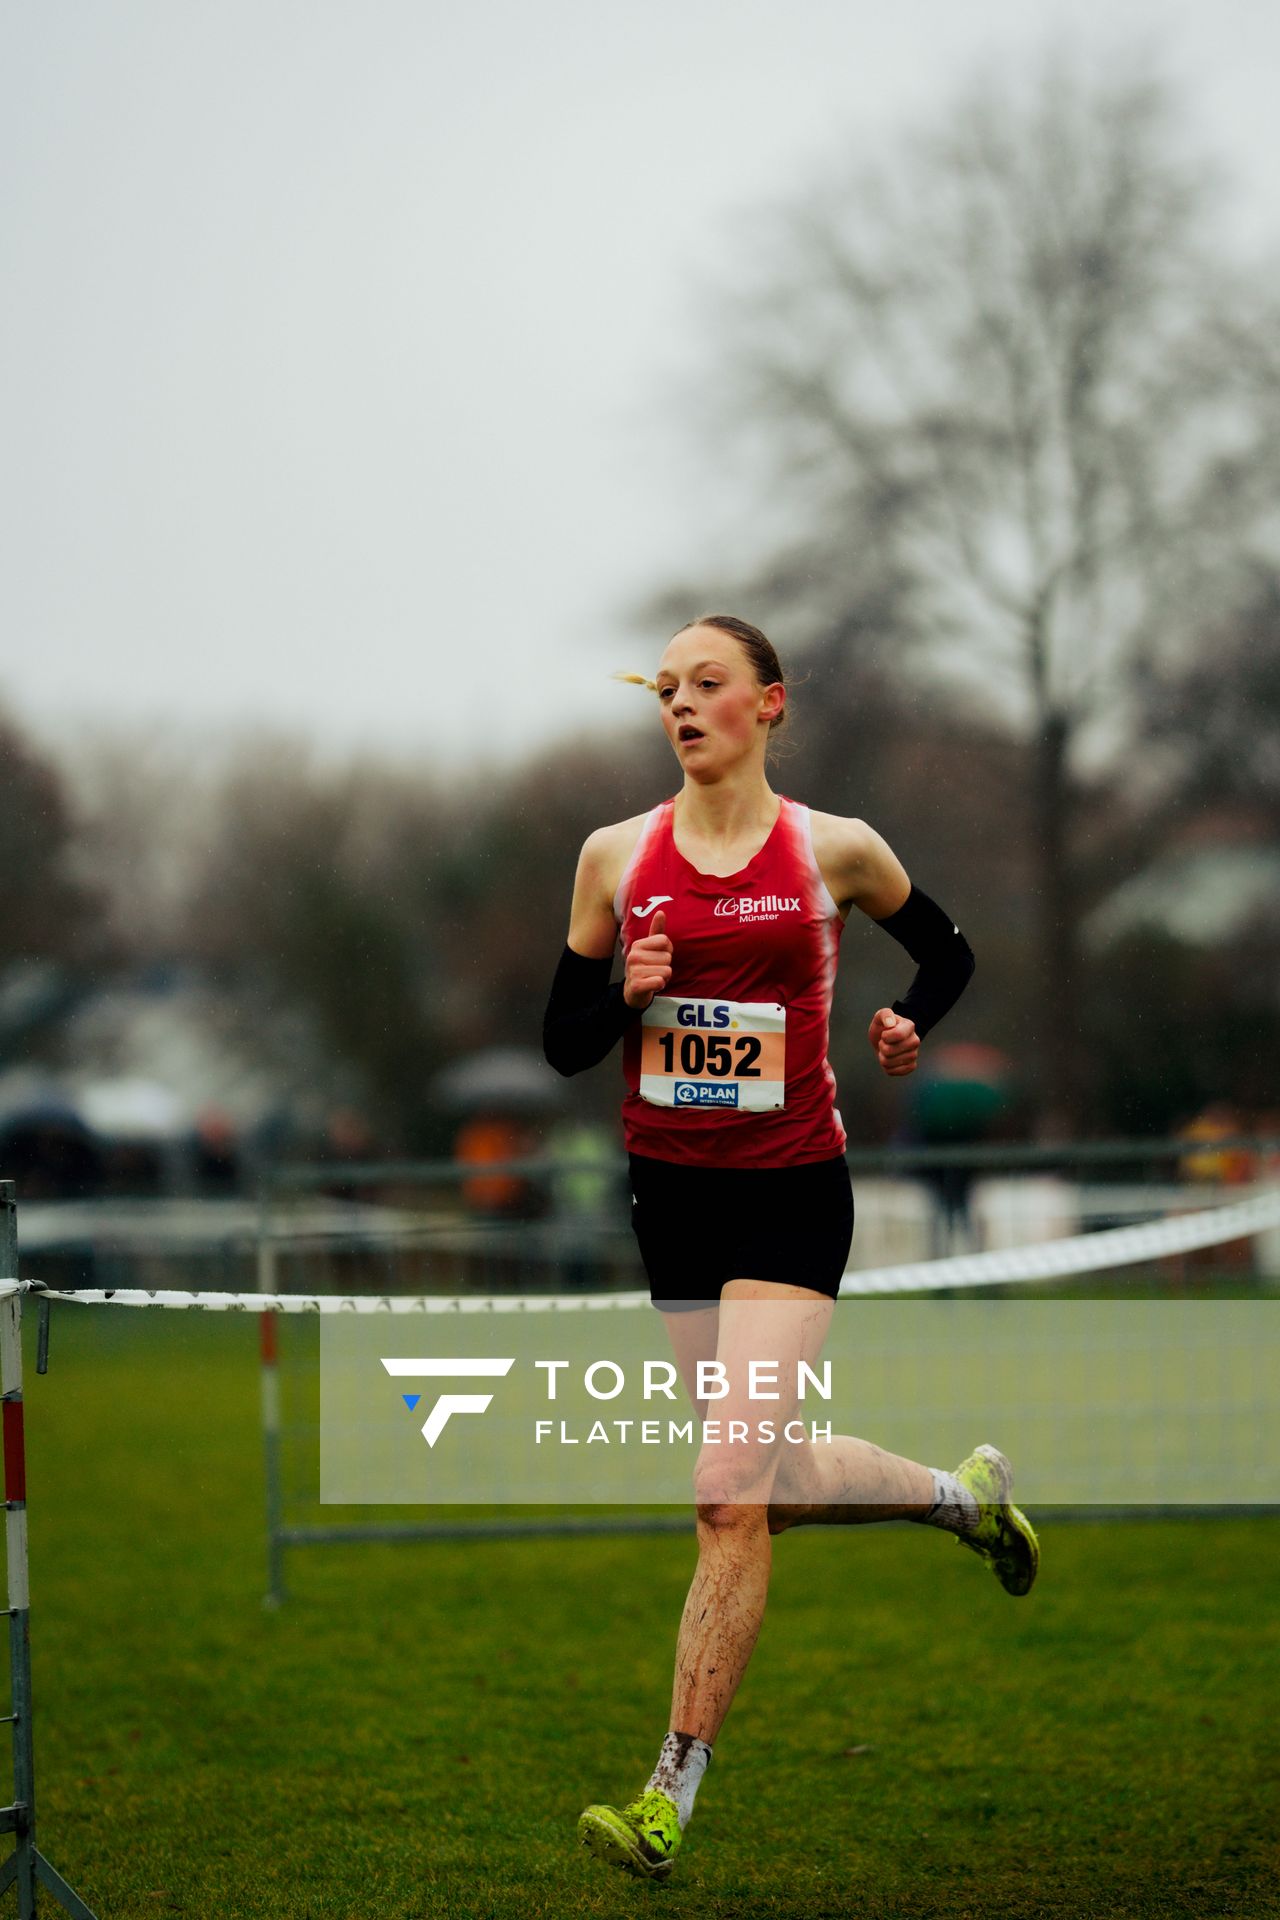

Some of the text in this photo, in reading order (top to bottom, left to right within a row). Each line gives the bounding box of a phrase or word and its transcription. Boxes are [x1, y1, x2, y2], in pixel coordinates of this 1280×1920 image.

[739, 895, 801, 914] Brillux
[739, 913, 779, 923] Münster
[659, 1032, 761, 1077] 1052
[699, 1087, 735, 1099] PLAN
